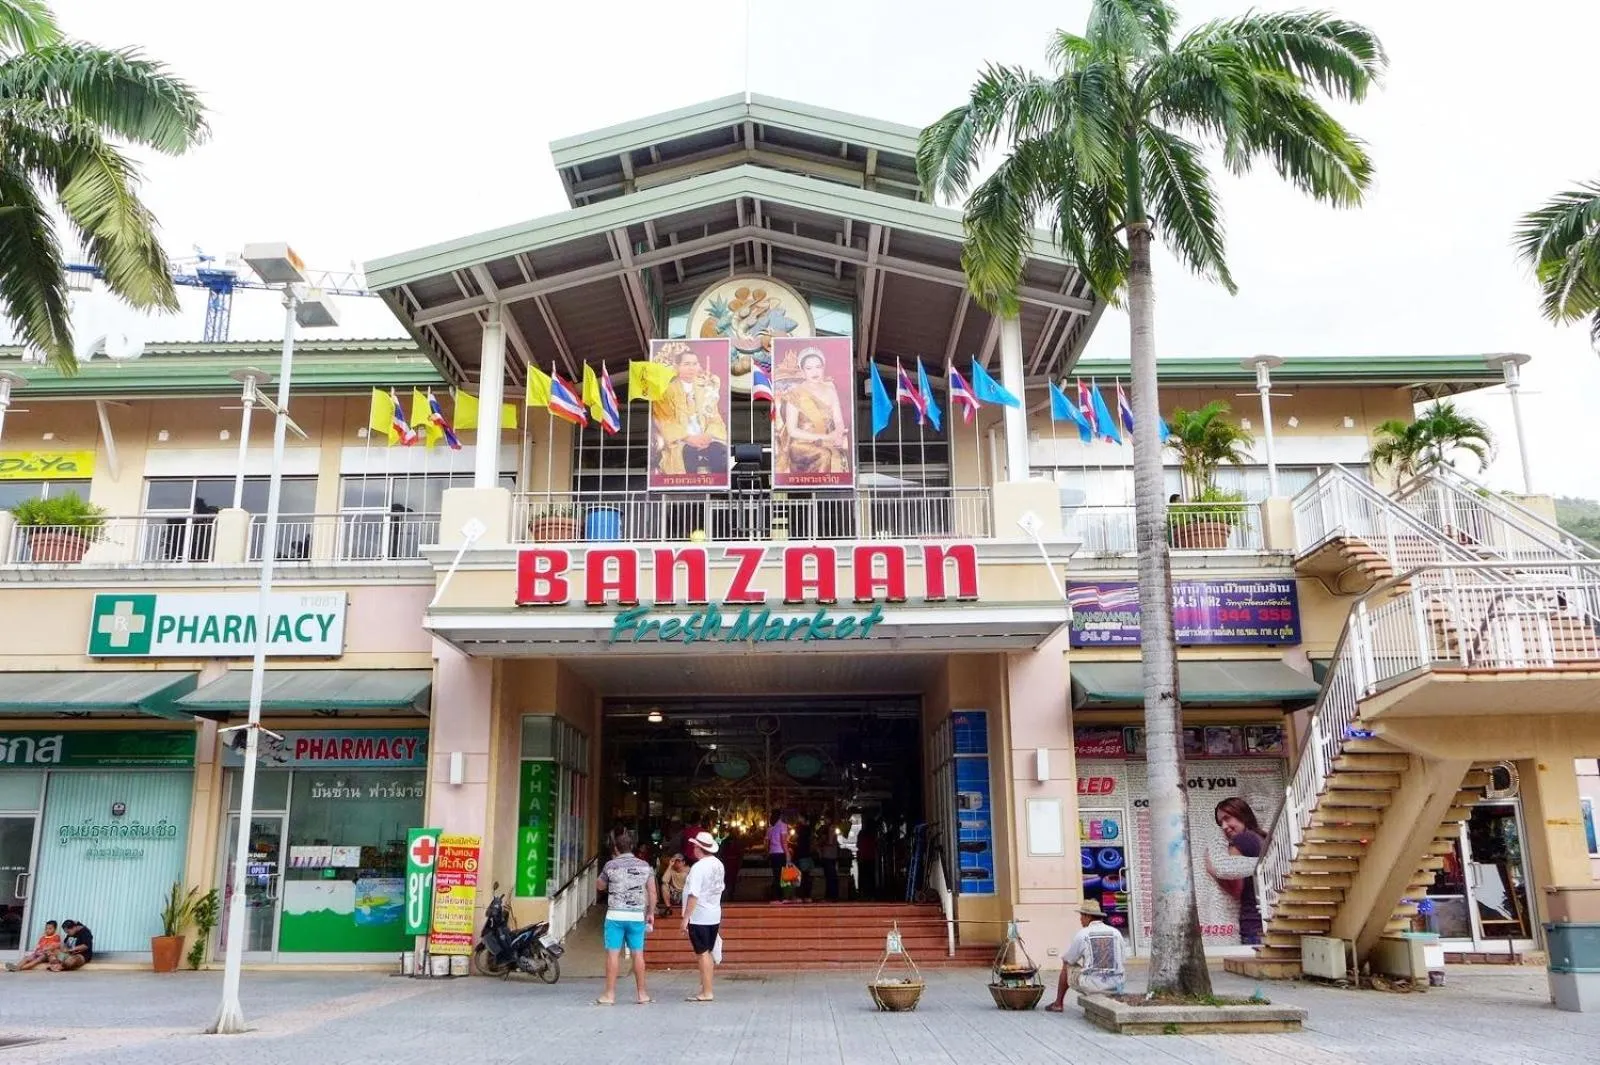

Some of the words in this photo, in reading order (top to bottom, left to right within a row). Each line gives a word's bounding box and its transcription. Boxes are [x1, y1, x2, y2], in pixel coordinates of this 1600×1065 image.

[664, 475, 714, 485] ทรงพระเจริญ
[788, 474, 840, 484] ทรงพระเจริญ
[515, 544, 979, 605] BANZAAN
[156, 612, 336, 644] PHARMACY
[609, 603, 722, 645] Fresh
[727, 604, 884, 642] Market
[295, 736, 417, 760] PHARMACY
[1207, 777, 1236, 790] you
[527, 764, 542, 895] PHARMACY
[1079, 818, 1119, 840] LED
